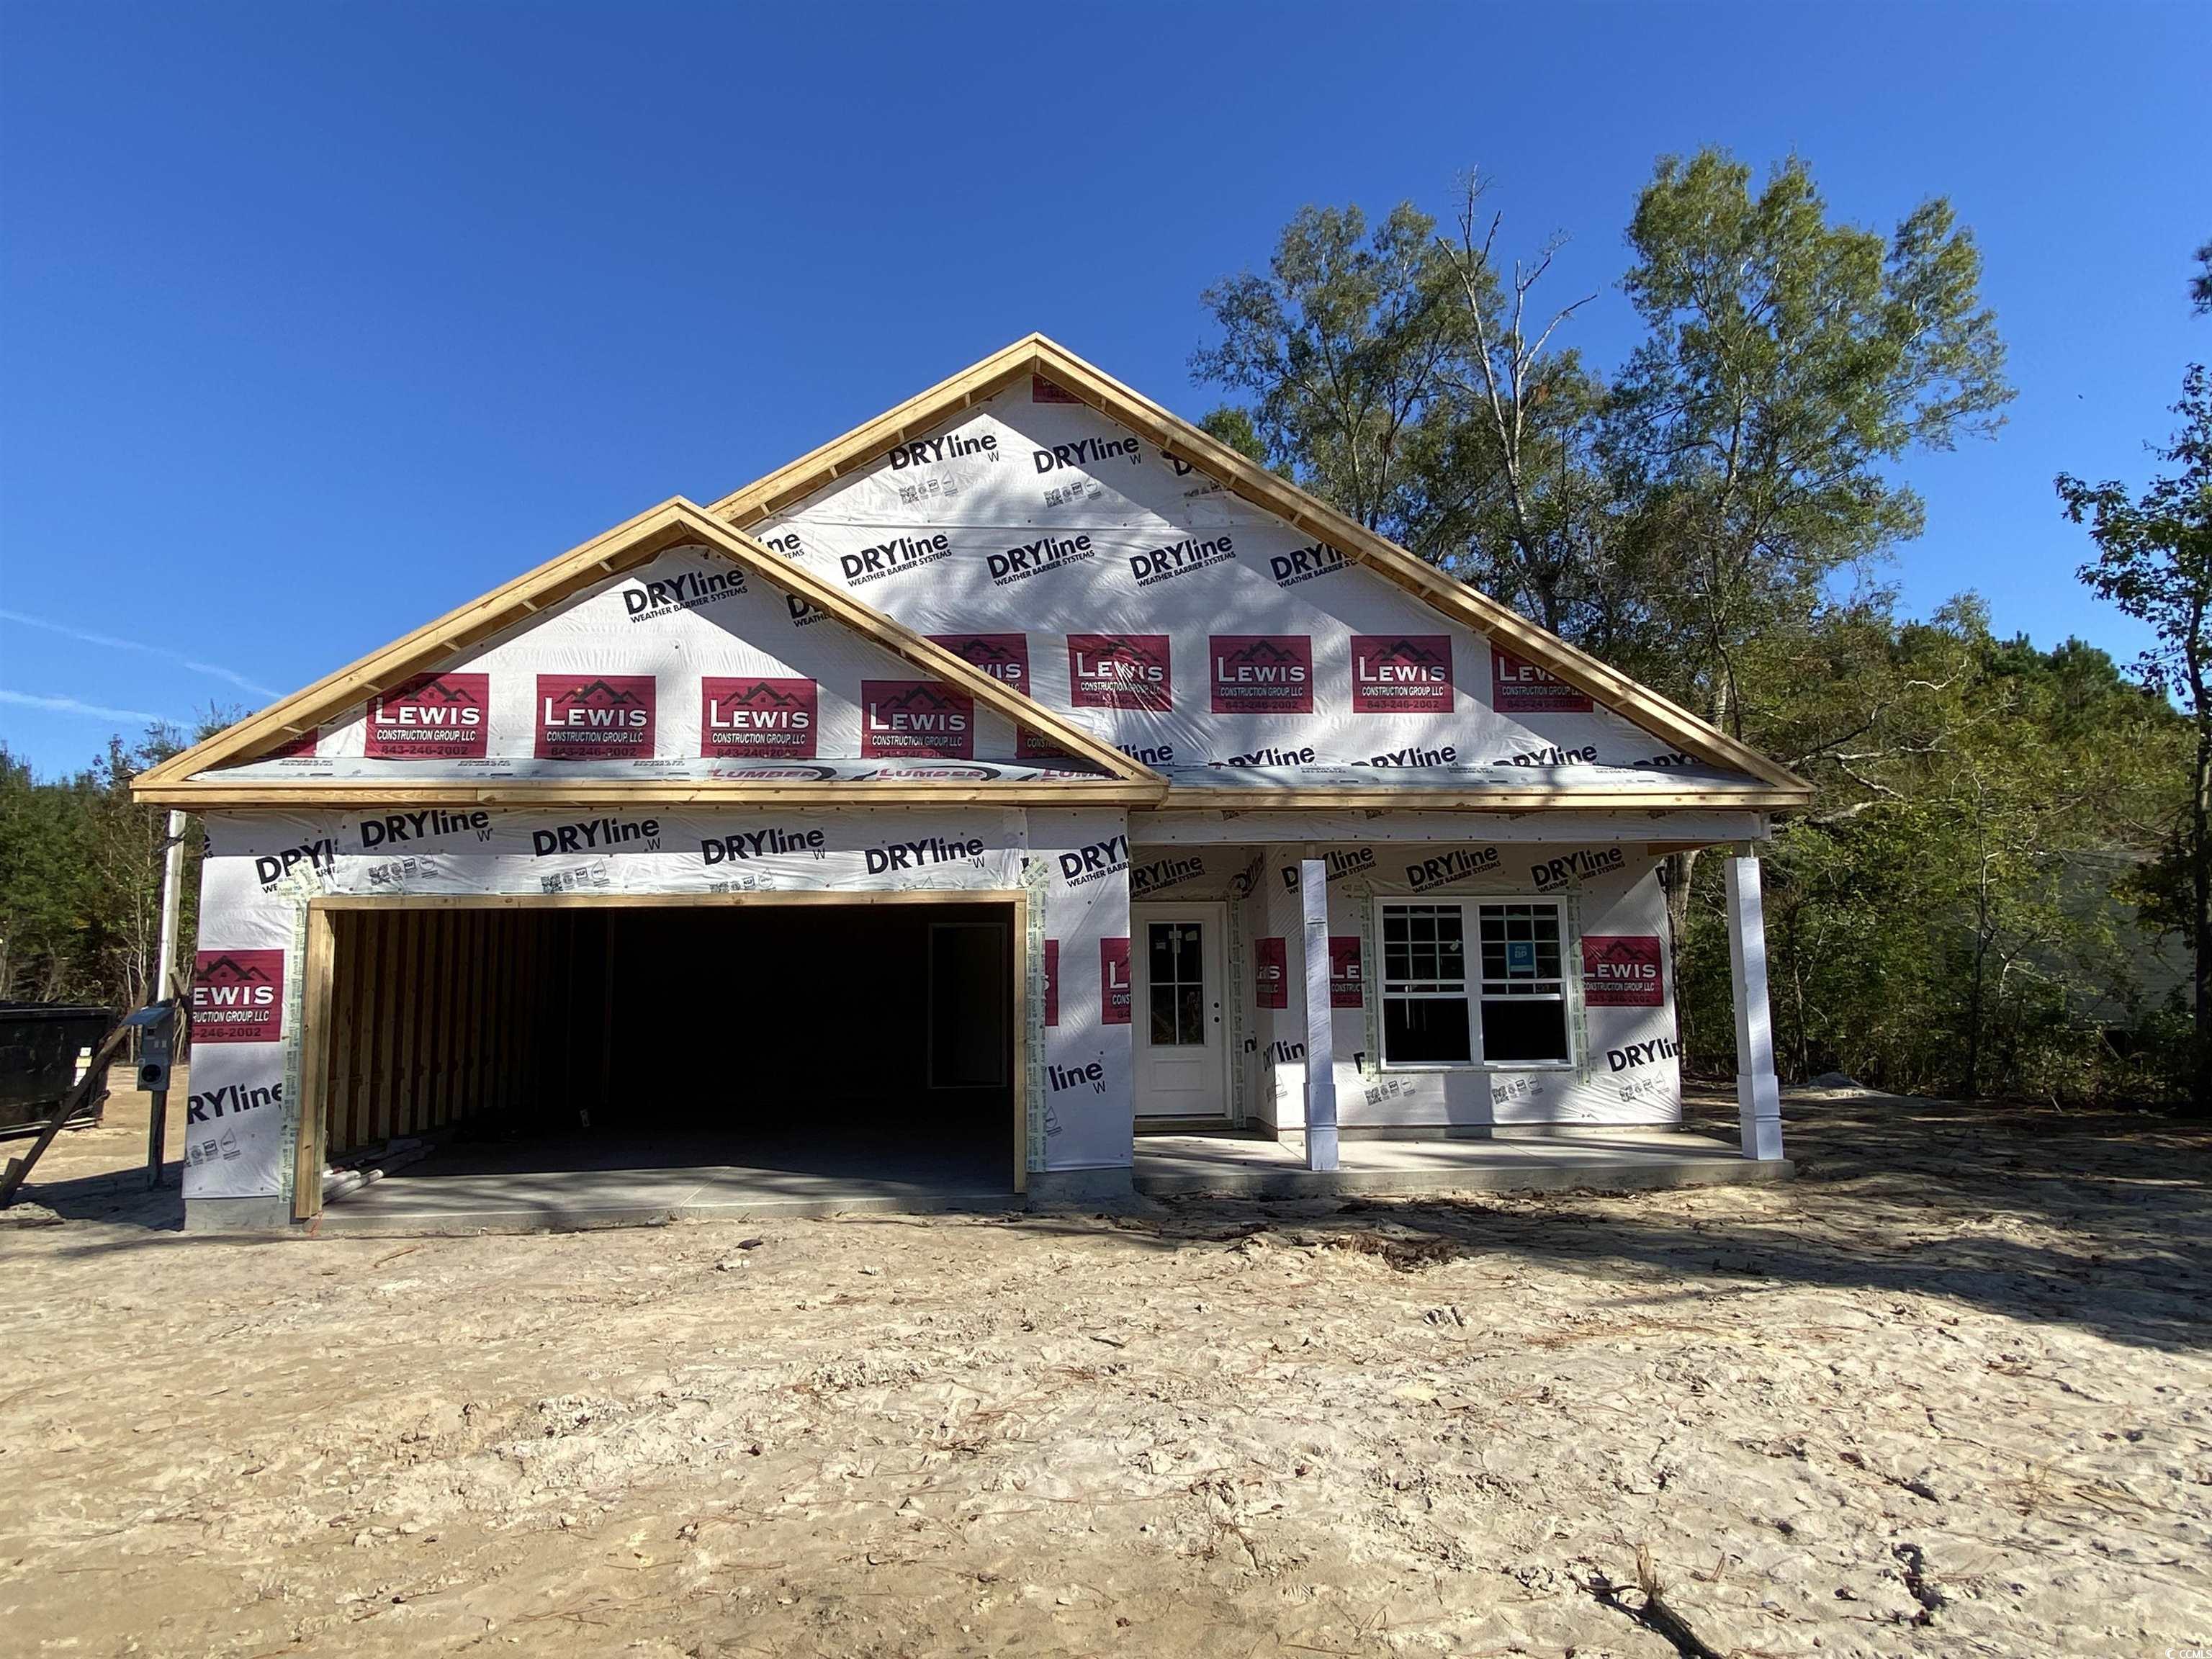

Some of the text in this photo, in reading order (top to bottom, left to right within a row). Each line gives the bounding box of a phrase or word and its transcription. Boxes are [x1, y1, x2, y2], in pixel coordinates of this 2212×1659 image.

[889, 434, 997, 471] DRYline
[988, 451, 999, 462] W
[1033, 436, 1139, 474] DRYline
[1130, 454, 1142, 465] W
[840, 534, 949, 580] DRYline
[848, 549, 952, 588] WEATHER BARRIER SYSTEMS
[986, 534, 1092, 579] DRYline
[994, 549, 1095, 587] WEATHER BARRIER SYSTEMS
[1129, 536, 1233, 580] DRYline
[1137, 550, 1236, 588] WEATHER BARRIER SYSTEMS
[1277, 562, 1344, 588] WEATHER BARRIER
[622, 569, 745, 616] DRYline
[631, 585, 748, 624] WEATHER BARRIER SYSTEMS
[1076, 652, 1164, 682] LEWIS
[1218, 656, 1305, 683] LEWIS
[1359, 656, 1445, 682] LEWIS
[1220, 686, 1267, 697] CONSTRUCTION
[1290, 686, 1303, 697] LLC
[1362, 685, 1408, 696] CONSTRUCTION
[1431, 685, 1444, 696] LLC
[1502, 685, 1548, 696] CONSTRUCTION
[374, 697, 481, 726] LEWIS
[544, 697, 647, 727] LEWIS
[710, 698, 809, 729] LEWIS
[870, 702, 966, 732] LEWIS
[377, 729, 433, 741] CONSTRUCTION
[462, 729, 477, 741] LLC
[547, 731, 602, 743] CONSTRUCTION
[629, 732, 644, 743] LLC
[712, 732, 765, 745] CONSTRUCTION
[793, 733, 806, 745] LLC
[872, 735, 924, 747] CONSTRUCTION
[949, 735, 963, 747] LLC
[1116, 743, 1174, 765] line
[1209, 746, 1316, 767] RYline
[1351, 745, 1457, 766] RYline
[1493, 745, 1597, 766] RYline
[361, 809, 490, 848] DRYline
[477, 827, 493, 842] W
[533, 817, 660, 857] DRYline
[647, 837, 661, 850] W
[701, 827, 825, 866] DRYline
[813, 848, 826, 860] W
[866, 835, 984, 875] DRYline
[972, 856, 985, 869] W
[1059, 834, 1128, 880] DRYl
[1406, 848, 1498, 887] DRYline
[1531, 848, 1622, 886] DRYline
[1067, 869, 1106, 888] WEATHER
[1413, 880, 1445, 893] WEATHER
[193, 986, 274, 1005] EWIS
[1644, 982, 1655, 992] LLC
[254, 1010, 270, 1022] LLC
[1045, 1061, 1103, 1092] line
[1093, 1082, 1106, 1094] W
[187, 1082, 282, 1125] RYline
